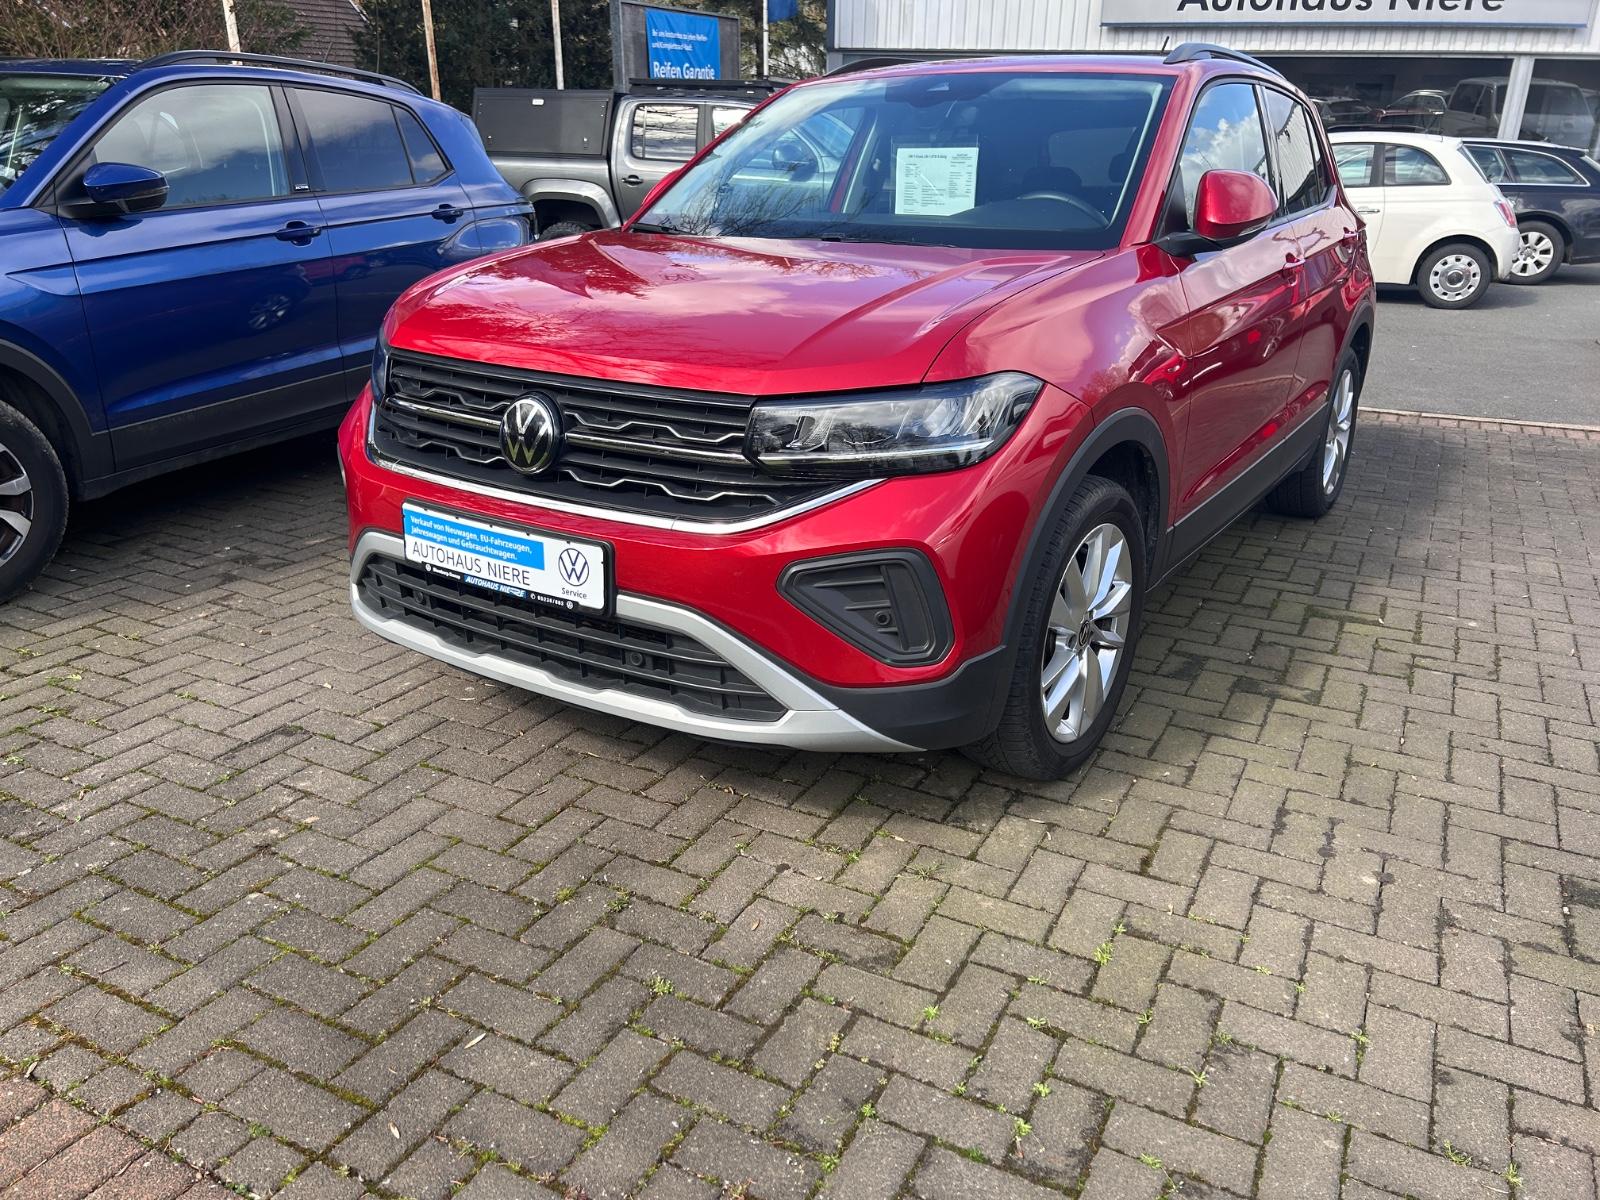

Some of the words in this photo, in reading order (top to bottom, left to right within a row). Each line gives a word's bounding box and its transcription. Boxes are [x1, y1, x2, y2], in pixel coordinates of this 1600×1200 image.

[653, 61, 682, 79] Reifen
[683, 62, 715, 80] Garantie
[410, 515, 433, 529] Verkauf
[434, 522, 445, 531] von
[445, 525, 479, 541] Neuwagen,
[480, 534, 533, 554] EU-Fahrzeugen,
[410, 526, 448, 543] Jahreswagen
[448, 537, 460, 546] und
[461, 539, 518, 560] Gebrauchtwagen.
[412, 541, 482, 574] AUTOHAUS
[487, 561, 531, 586] NIERE
[465, 575, 499, 590] AUTOHAUS
[561, 587, 588, 600] Service
